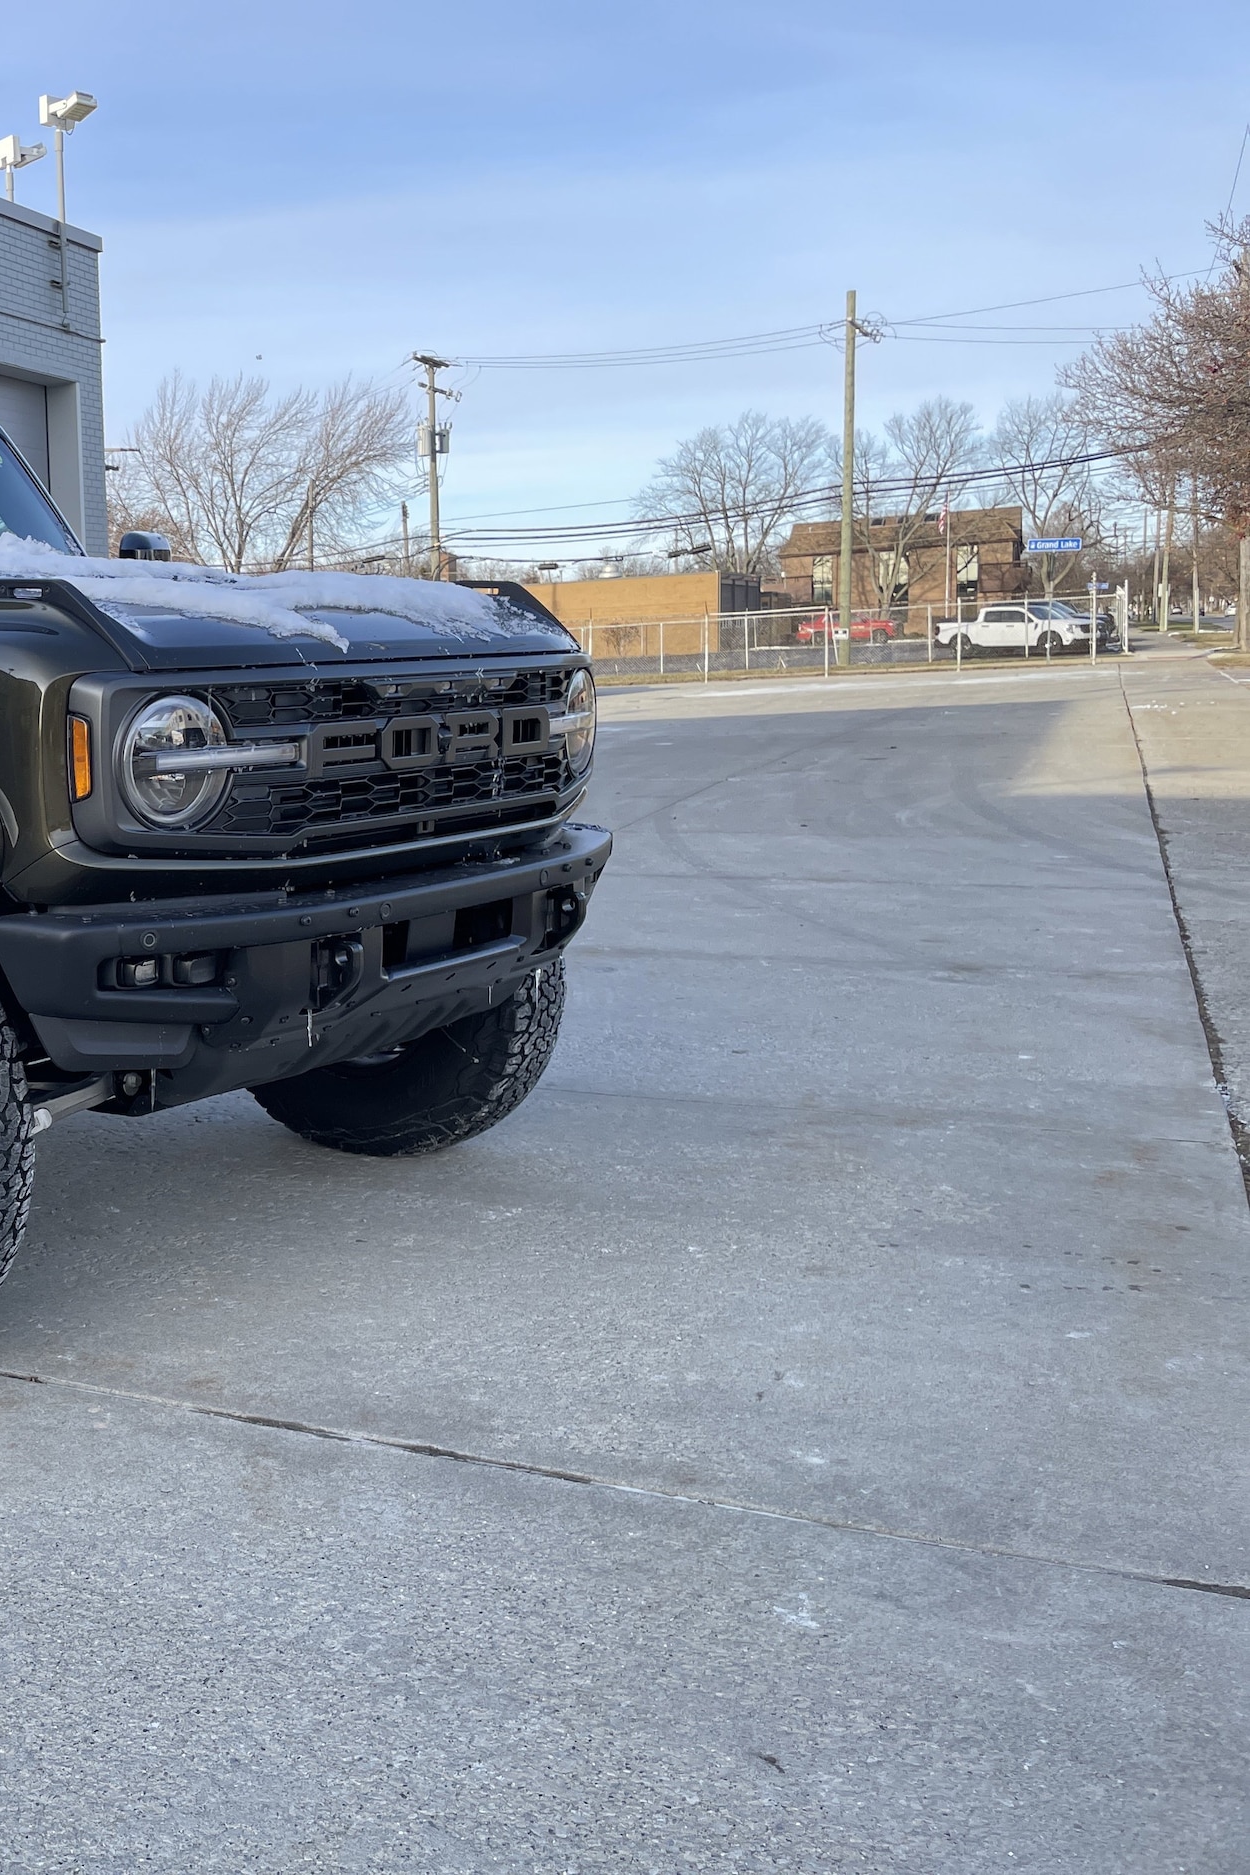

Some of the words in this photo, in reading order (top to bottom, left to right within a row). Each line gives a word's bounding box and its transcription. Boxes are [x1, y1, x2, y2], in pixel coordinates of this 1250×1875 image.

[1036, 540, 1059, 549] Grand
[1060, 540, 1078, 548] Lake
[308, 704, 550, 780] FORD
